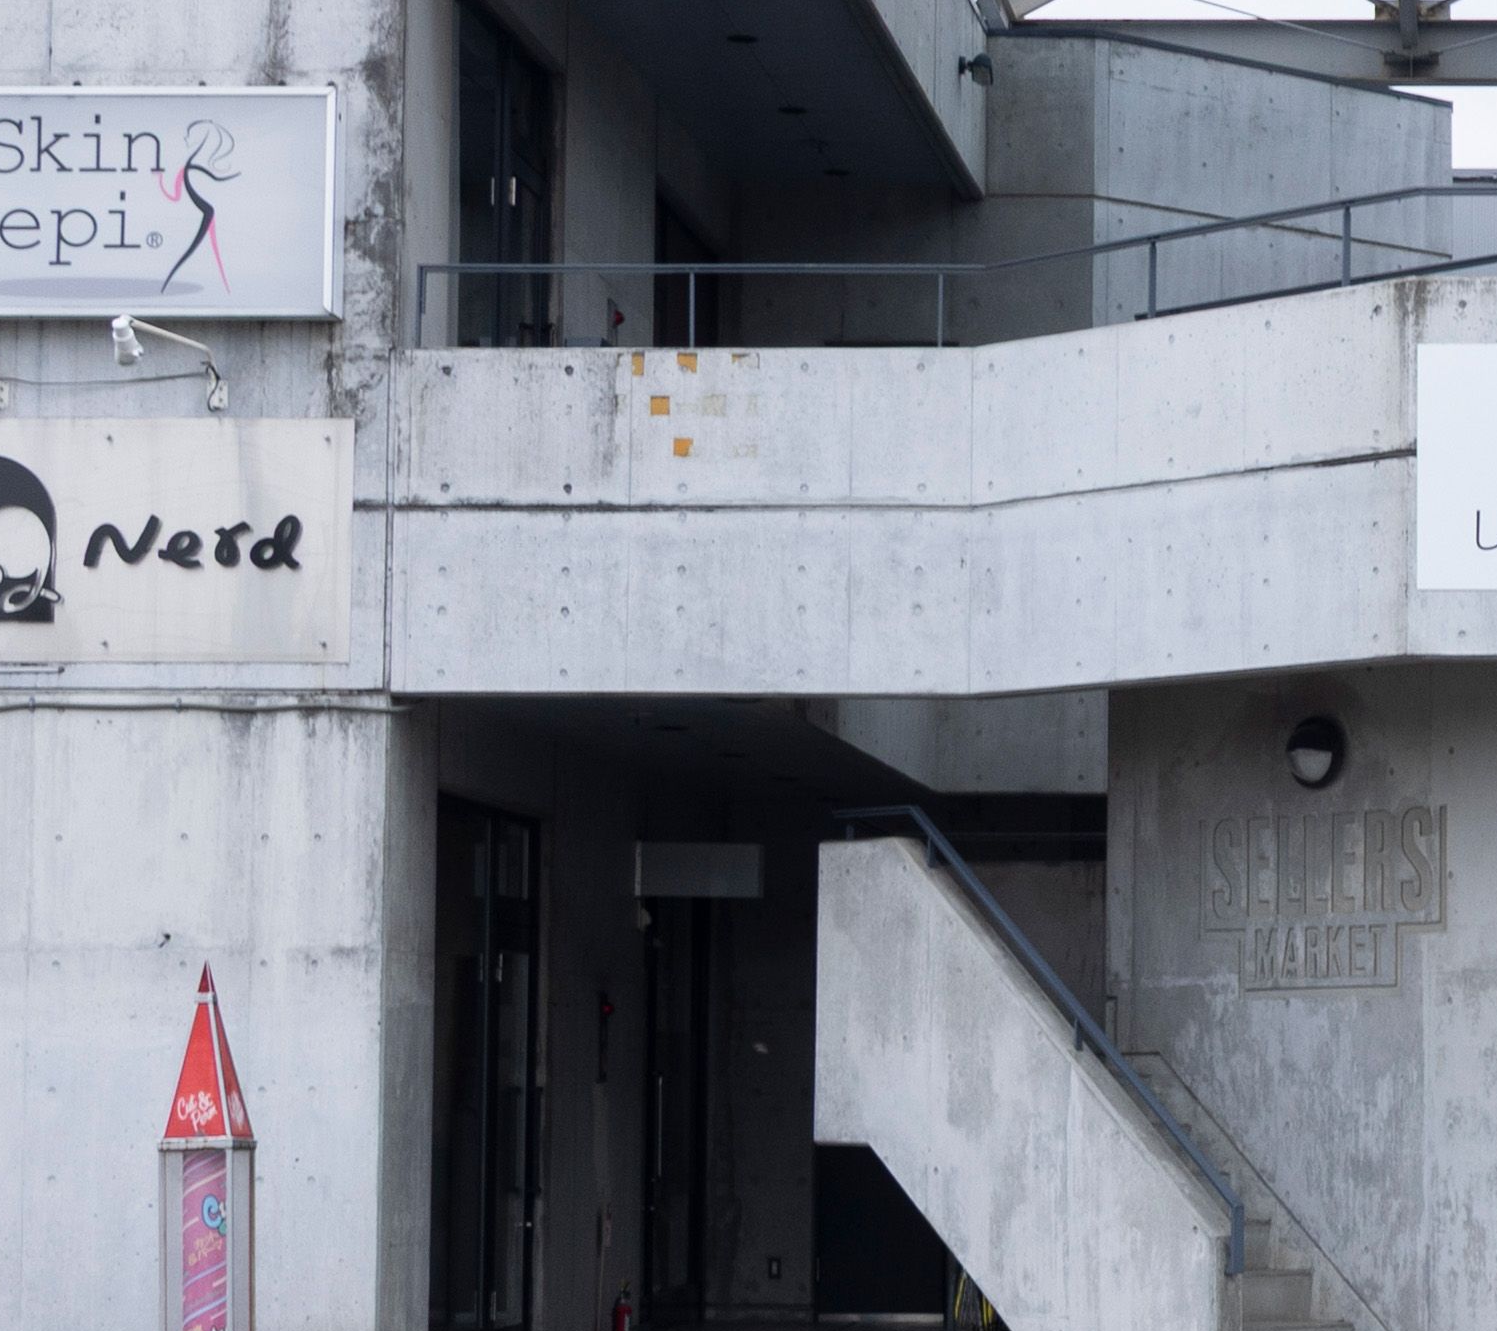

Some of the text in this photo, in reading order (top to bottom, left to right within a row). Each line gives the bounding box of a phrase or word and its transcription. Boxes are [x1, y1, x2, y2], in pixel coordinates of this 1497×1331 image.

[83, 513, 303, 570] Nerd
[1211, 805, 1434, 919] SELLERS
[1251, 923, 1388, 983] MARKET
